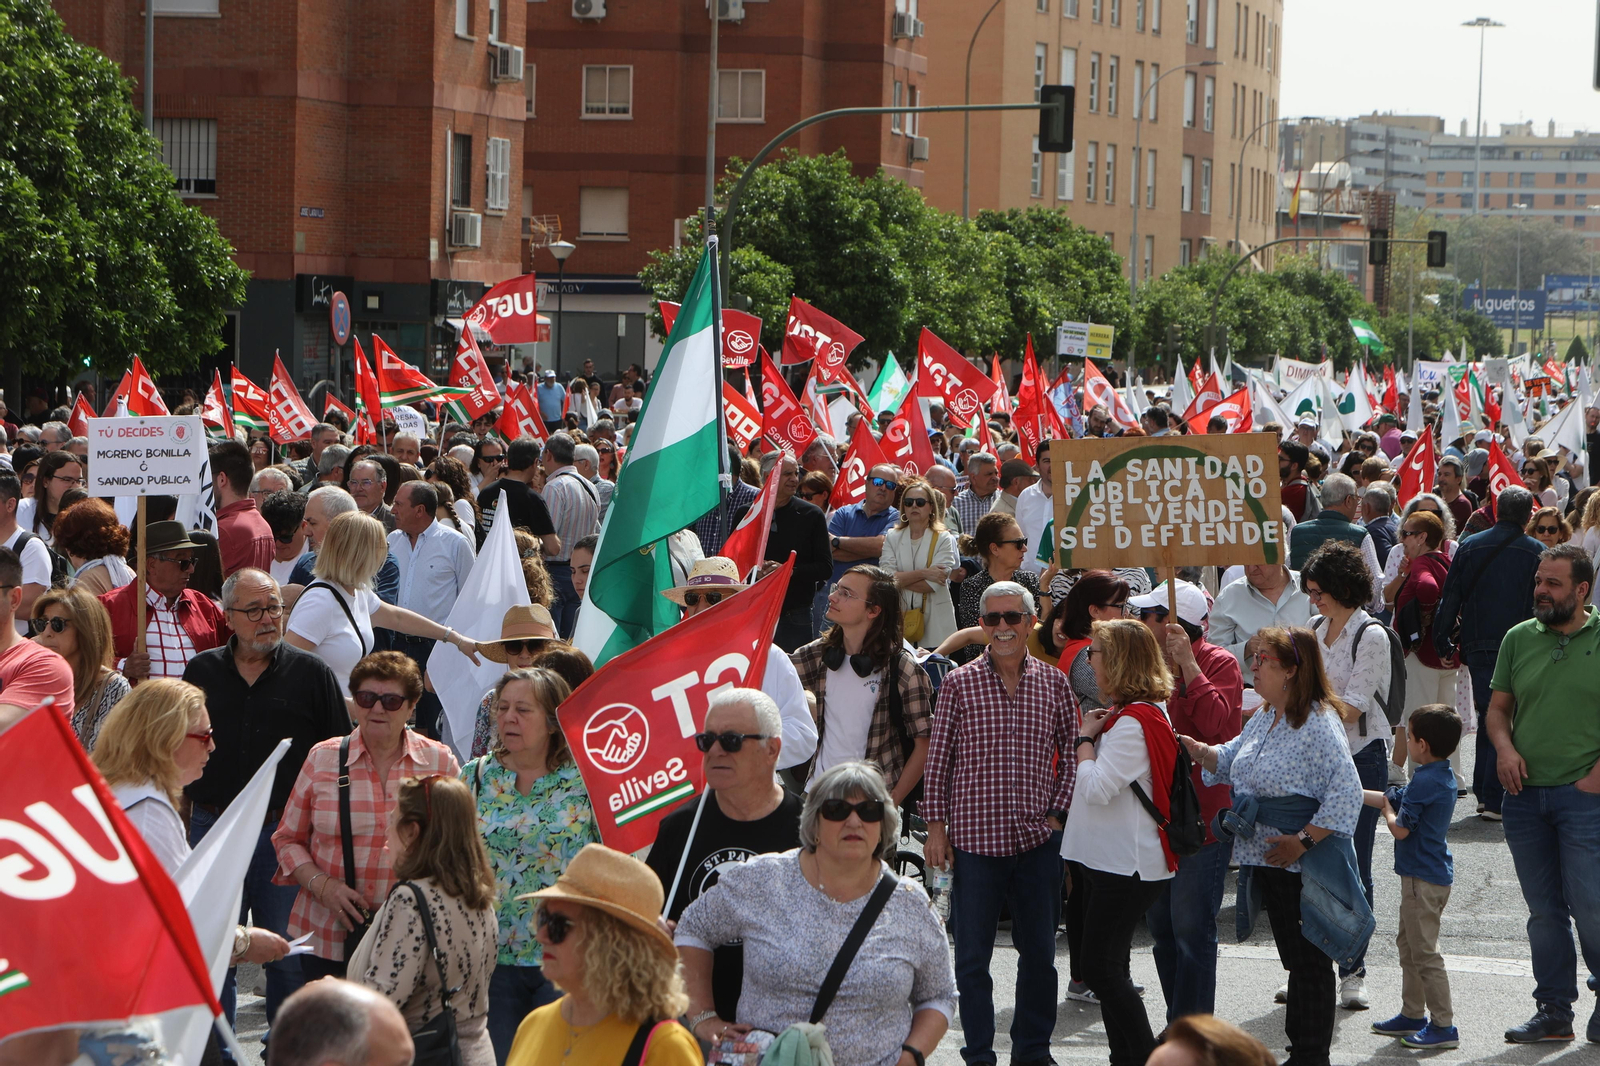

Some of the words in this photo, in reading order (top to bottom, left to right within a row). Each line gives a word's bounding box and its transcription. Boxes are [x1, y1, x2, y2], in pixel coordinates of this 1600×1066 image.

[720, 354, 749, 365] Sevilla
[269, 372, 313, 438] COO
[458, 375, 485, 409] Seilla
[761, 373, 796, 420] GT
[269, 409, 292, 440] Sevilla
[394, 413, 418, 421] RESAS
[399, 421, 418, 429] ADAS
[98, 426, 113, 438] TÚ
[117, 426, 165, 438] DECIDES
[767, 426, 796, 454] Sevilla
[885, 417, 914, 458] GT
[97, 449, 143, 459] MORENO
[145, 448, 192, 459] BONILLA
[97, 476, 144, 486] SANIDAD
[147, 475, 192, 485] PUBLICA
[1065, 460, 1106, 484] LA
[1126, 454, 1264, 481] SANIDAD
[1065, 479, 1205, 505] PUBLICA
[1226, 477, 1267, 500] NO
[1089, 503, 1124, 526] SE
[1145, 499, 1244, 525] VENDE
[1060, 526, 1097, 549] SE
[703, 853, 725, 871] ST.
[728, 851, 753, 862] PA
